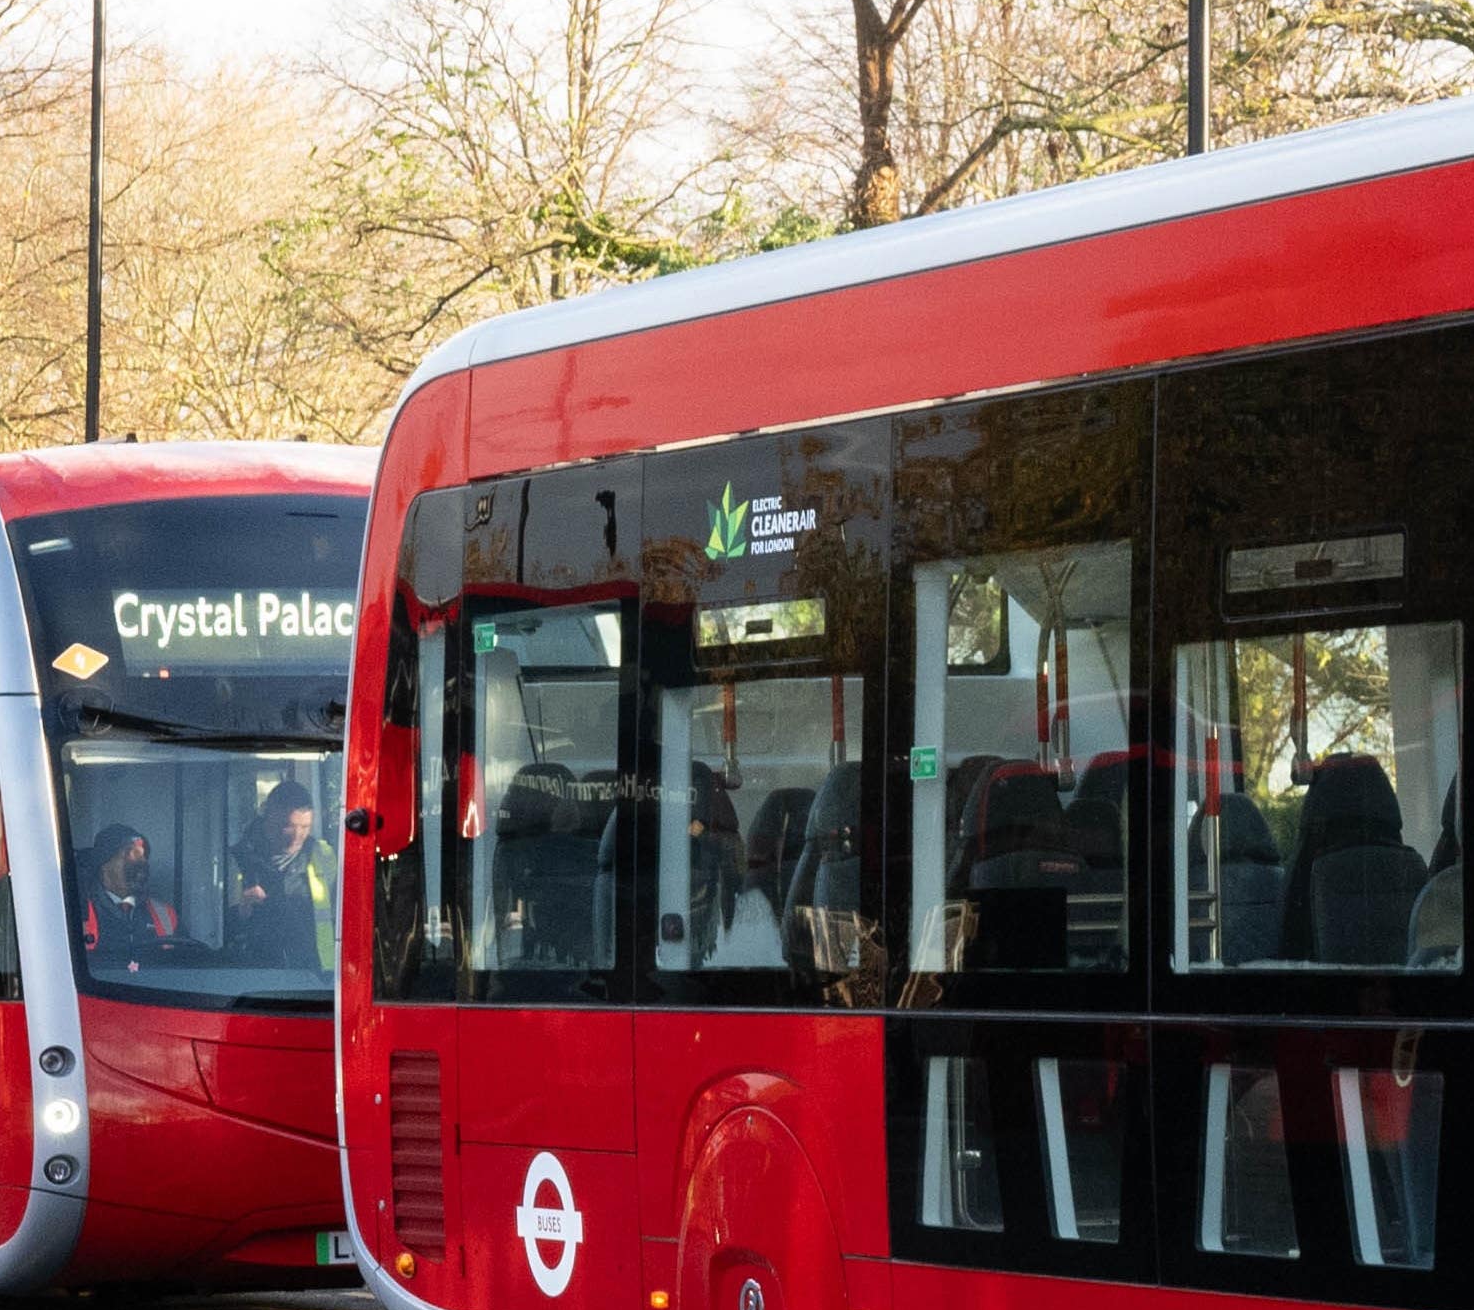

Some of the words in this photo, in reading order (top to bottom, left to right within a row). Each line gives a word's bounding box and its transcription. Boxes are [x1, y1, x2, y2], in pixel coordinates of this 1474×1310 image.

[752, 496, 783, 513] ELECTRIC
[751, 540, 764, 555] FOR
[765, 537, 795, 553] LONDON
[114, 592, 247, 649] Crystal
[259, 592, 355, 637] Palac
[537, 1215, 563, 1233] BUSES
